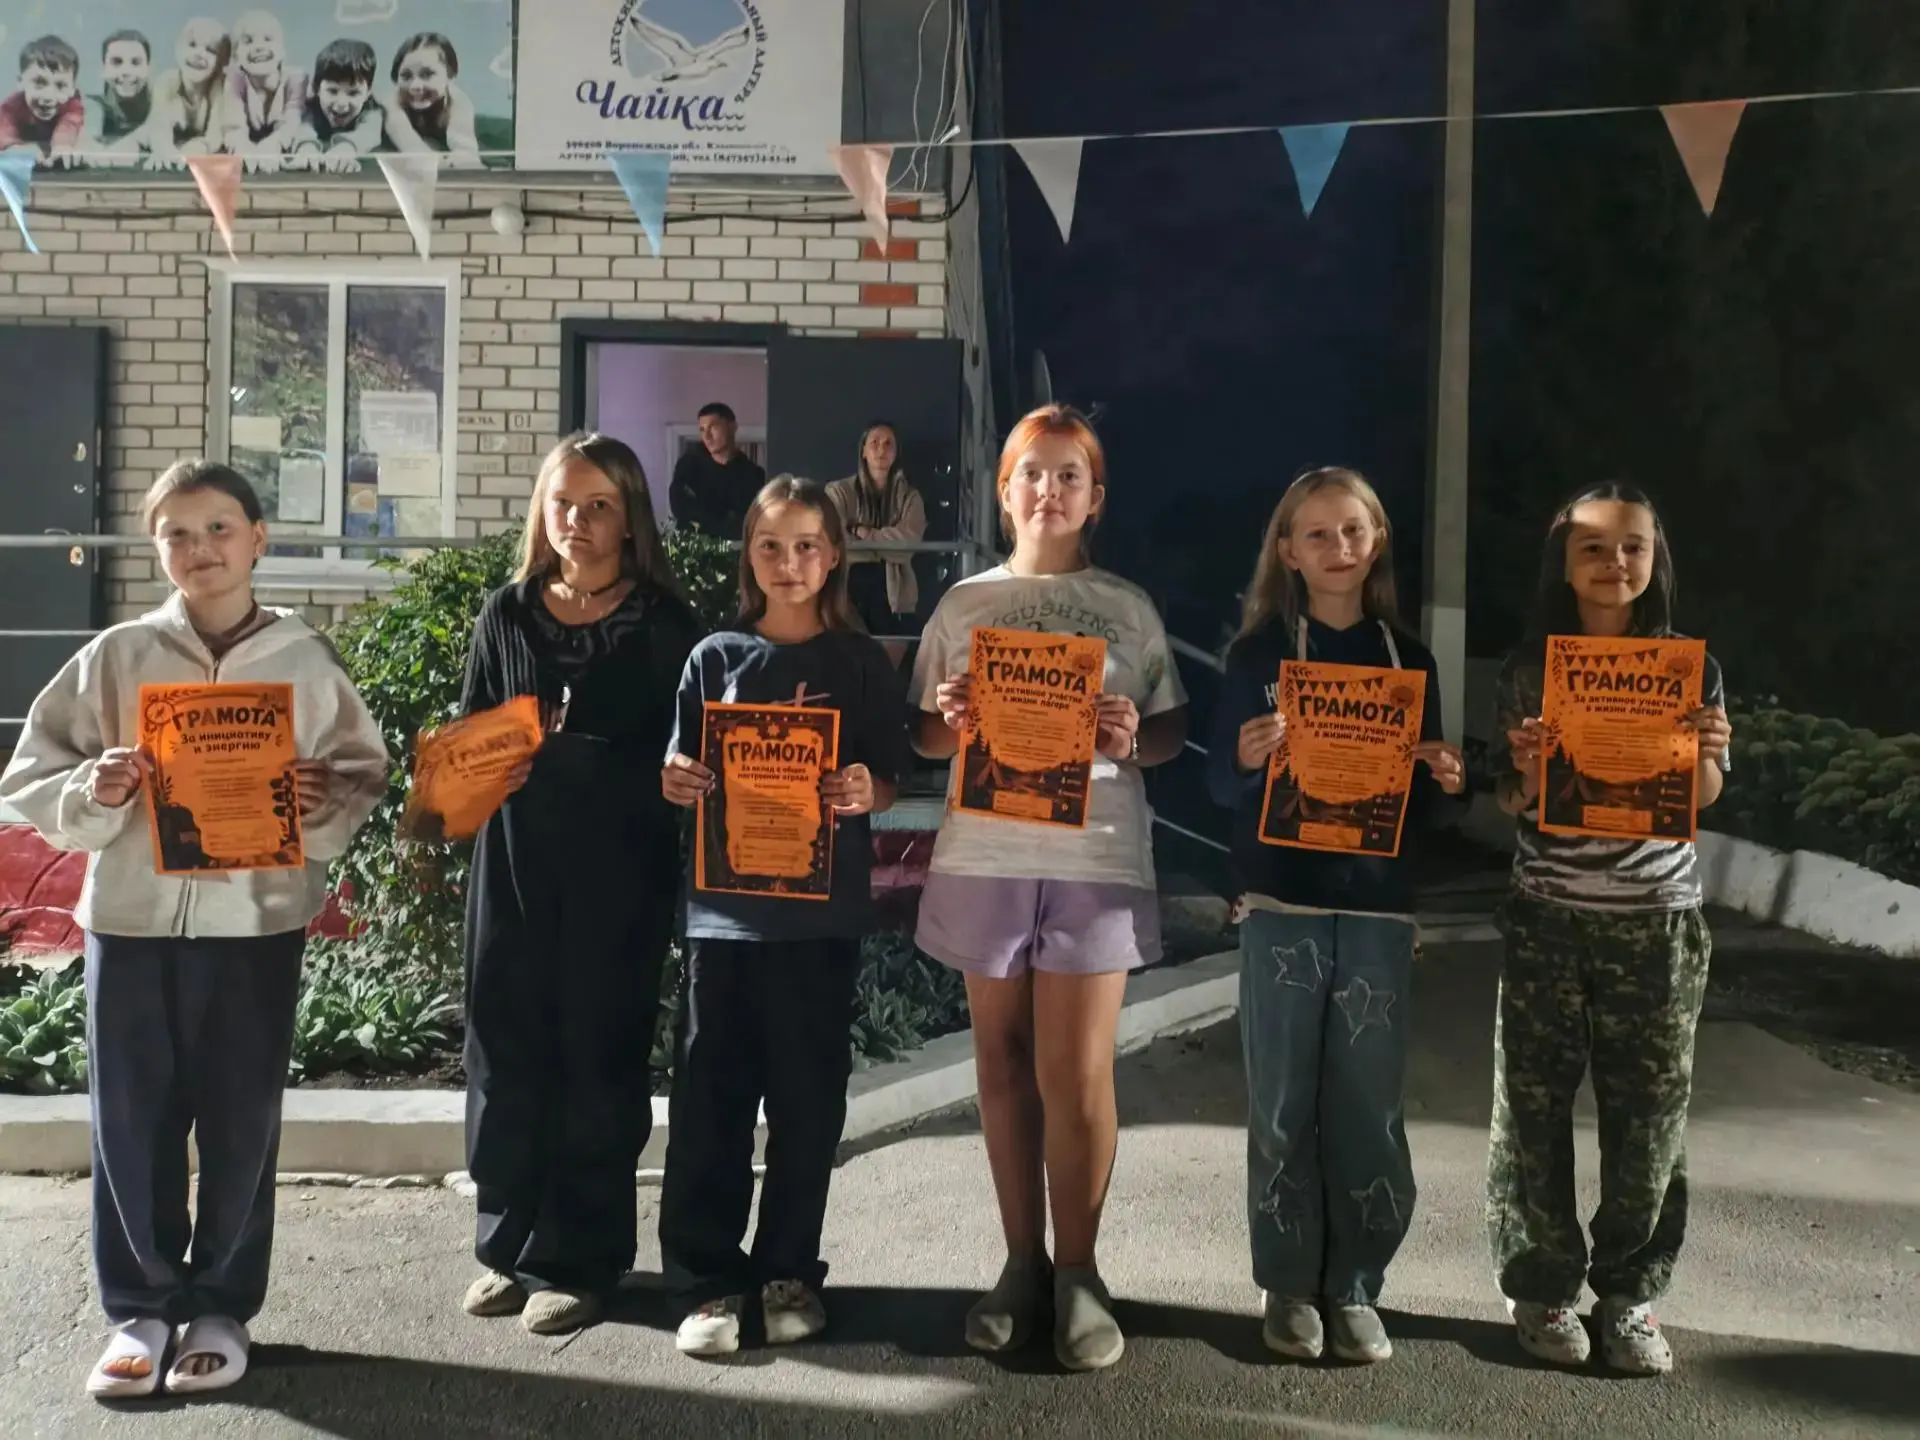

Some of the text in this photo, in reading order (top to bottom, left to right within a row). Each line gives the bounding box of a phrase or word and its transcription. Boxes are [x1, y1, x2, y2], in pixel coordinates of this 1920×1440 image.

[734, 48, 764, 104] ЛАГЕРЬ
[575, 80, 725, 131] Чайка
[987, 661, 1087, 695] ГРАМОТА
[1567, 670, 1682, 700] ГРАМОТА
[992, 684, 1083, 704] За активное участие
[1010, 695, 1038, 705] жизни
[1040, 699, 1070, 710] лагеря
[1574, 693, 1679, 709] За активное участие
[172, 706, 276, 731] ГРАМОТА
[1299, 695, 1405, 728] ГРАМОТА
[1594, 704, 1626, 713] жизни
[1629, 706, 1664, 717] лагеря
[181, 730, 271, 744] За инициативу
[1304, 718, 1401, 738] За активное участие
[1322, 730, 1352, 740] жизни
[1354, 733, 1386, 745] лагеря
[193, 741, 261, 754] и энергию
[728, 741, 817, 766] ГРАМОТА
